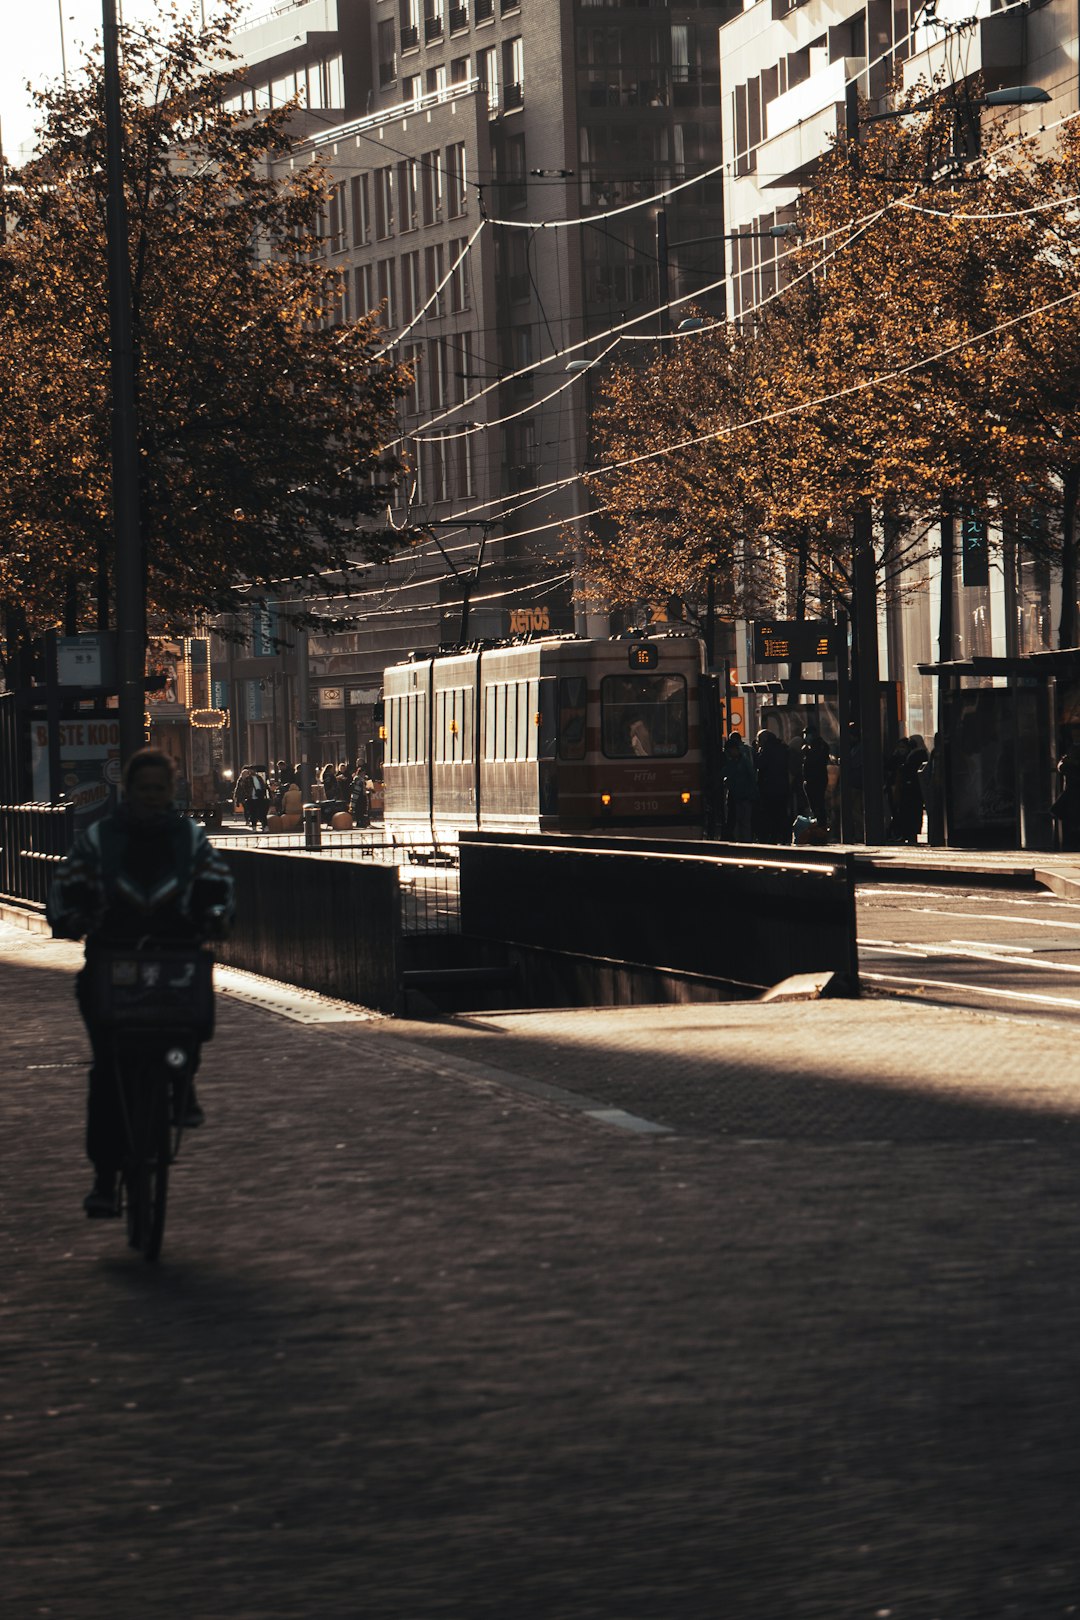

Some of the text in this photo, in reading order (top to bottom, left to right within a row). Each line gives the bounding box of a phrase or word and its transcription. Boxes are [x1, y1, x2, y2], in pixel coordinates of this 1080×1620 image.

[637, 650, 649, 663] 16
[37, 723, 119, 746] BSTE KOO
[633, 772, 656, 781] HTM
[634, 800, 658, 810] 3110
